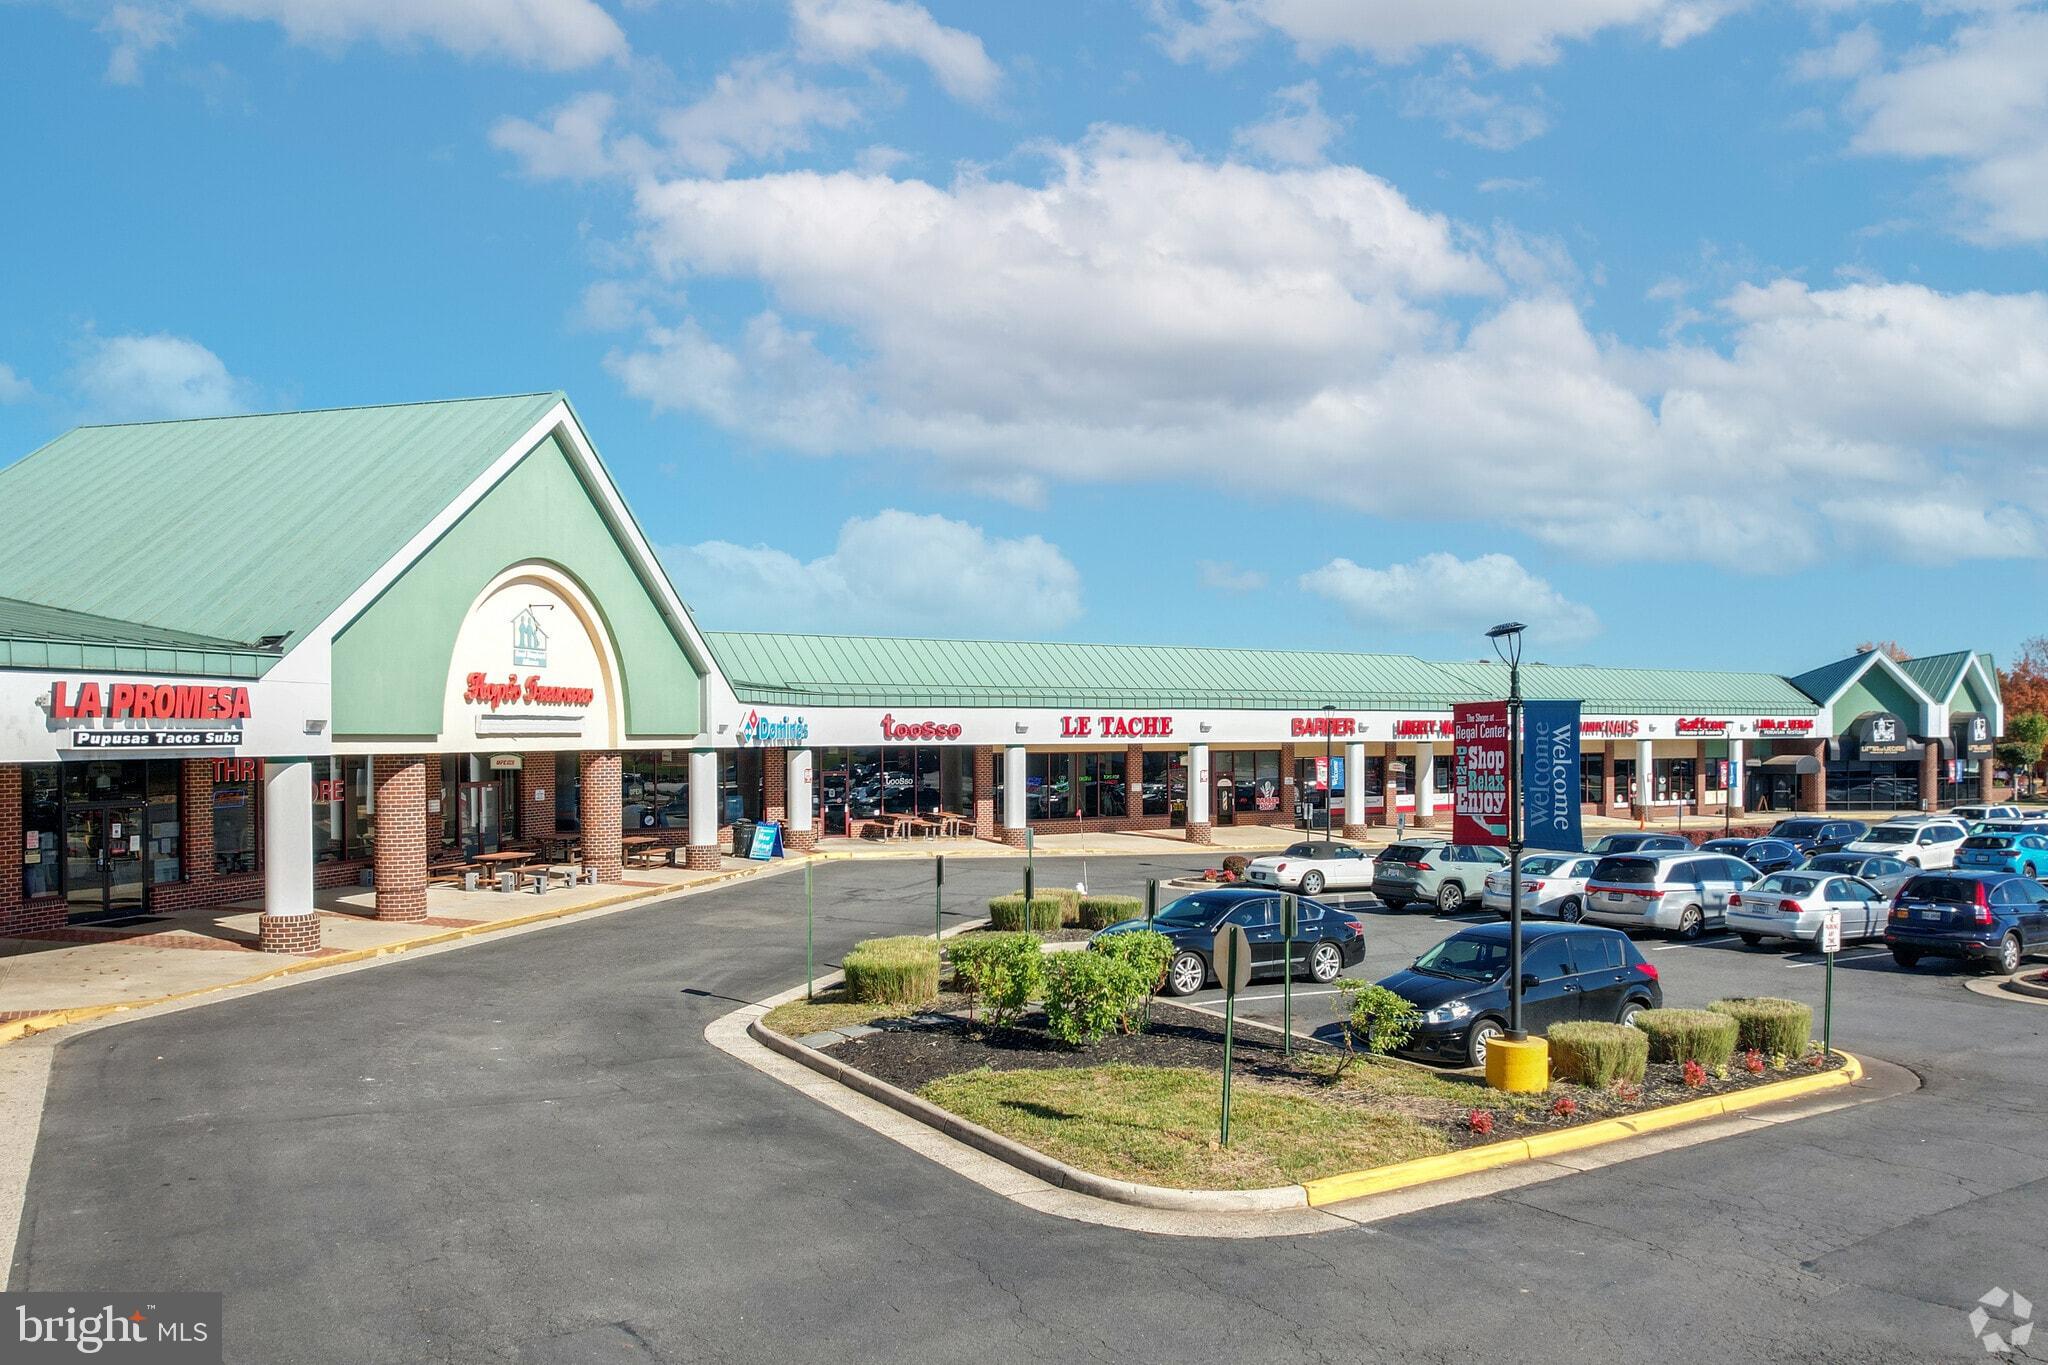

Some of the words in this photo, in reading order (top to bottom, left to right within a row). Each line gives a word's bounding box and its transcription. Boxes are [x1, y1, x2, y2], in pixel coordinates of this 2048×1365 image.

[53, 681, 102, 718] LA
[110, 683, 251, 719] PROMESA
[1061, 716, 1092, 736] LE
[1099, 716, 1173, 737] TACHE
[1465, 713, 1475, 723] The
[1475, 713, 1489, 724] Shops
[1606, 719, 1639, 735] NAILS
[77, 732, 149, 747] Pupusas
[156, 732, 200, 744] Tacos
[205, 732, 240, 744] Subs
[1455, 724, 1478, 742] Regal
[1480, 723, 1506, 739] Center
[212, 758, 265, 783] THRI
[1456, 745, 1467, 786] DINE
[1468, 745, 1505, 775] Shop
[1468, 770, 1505, 792] Relax
[1529, 721, 1551, 828] Welcome
[1552, 721, 1572, 831] Welcome
[1456, 786, 1506, 814] Enjoy
